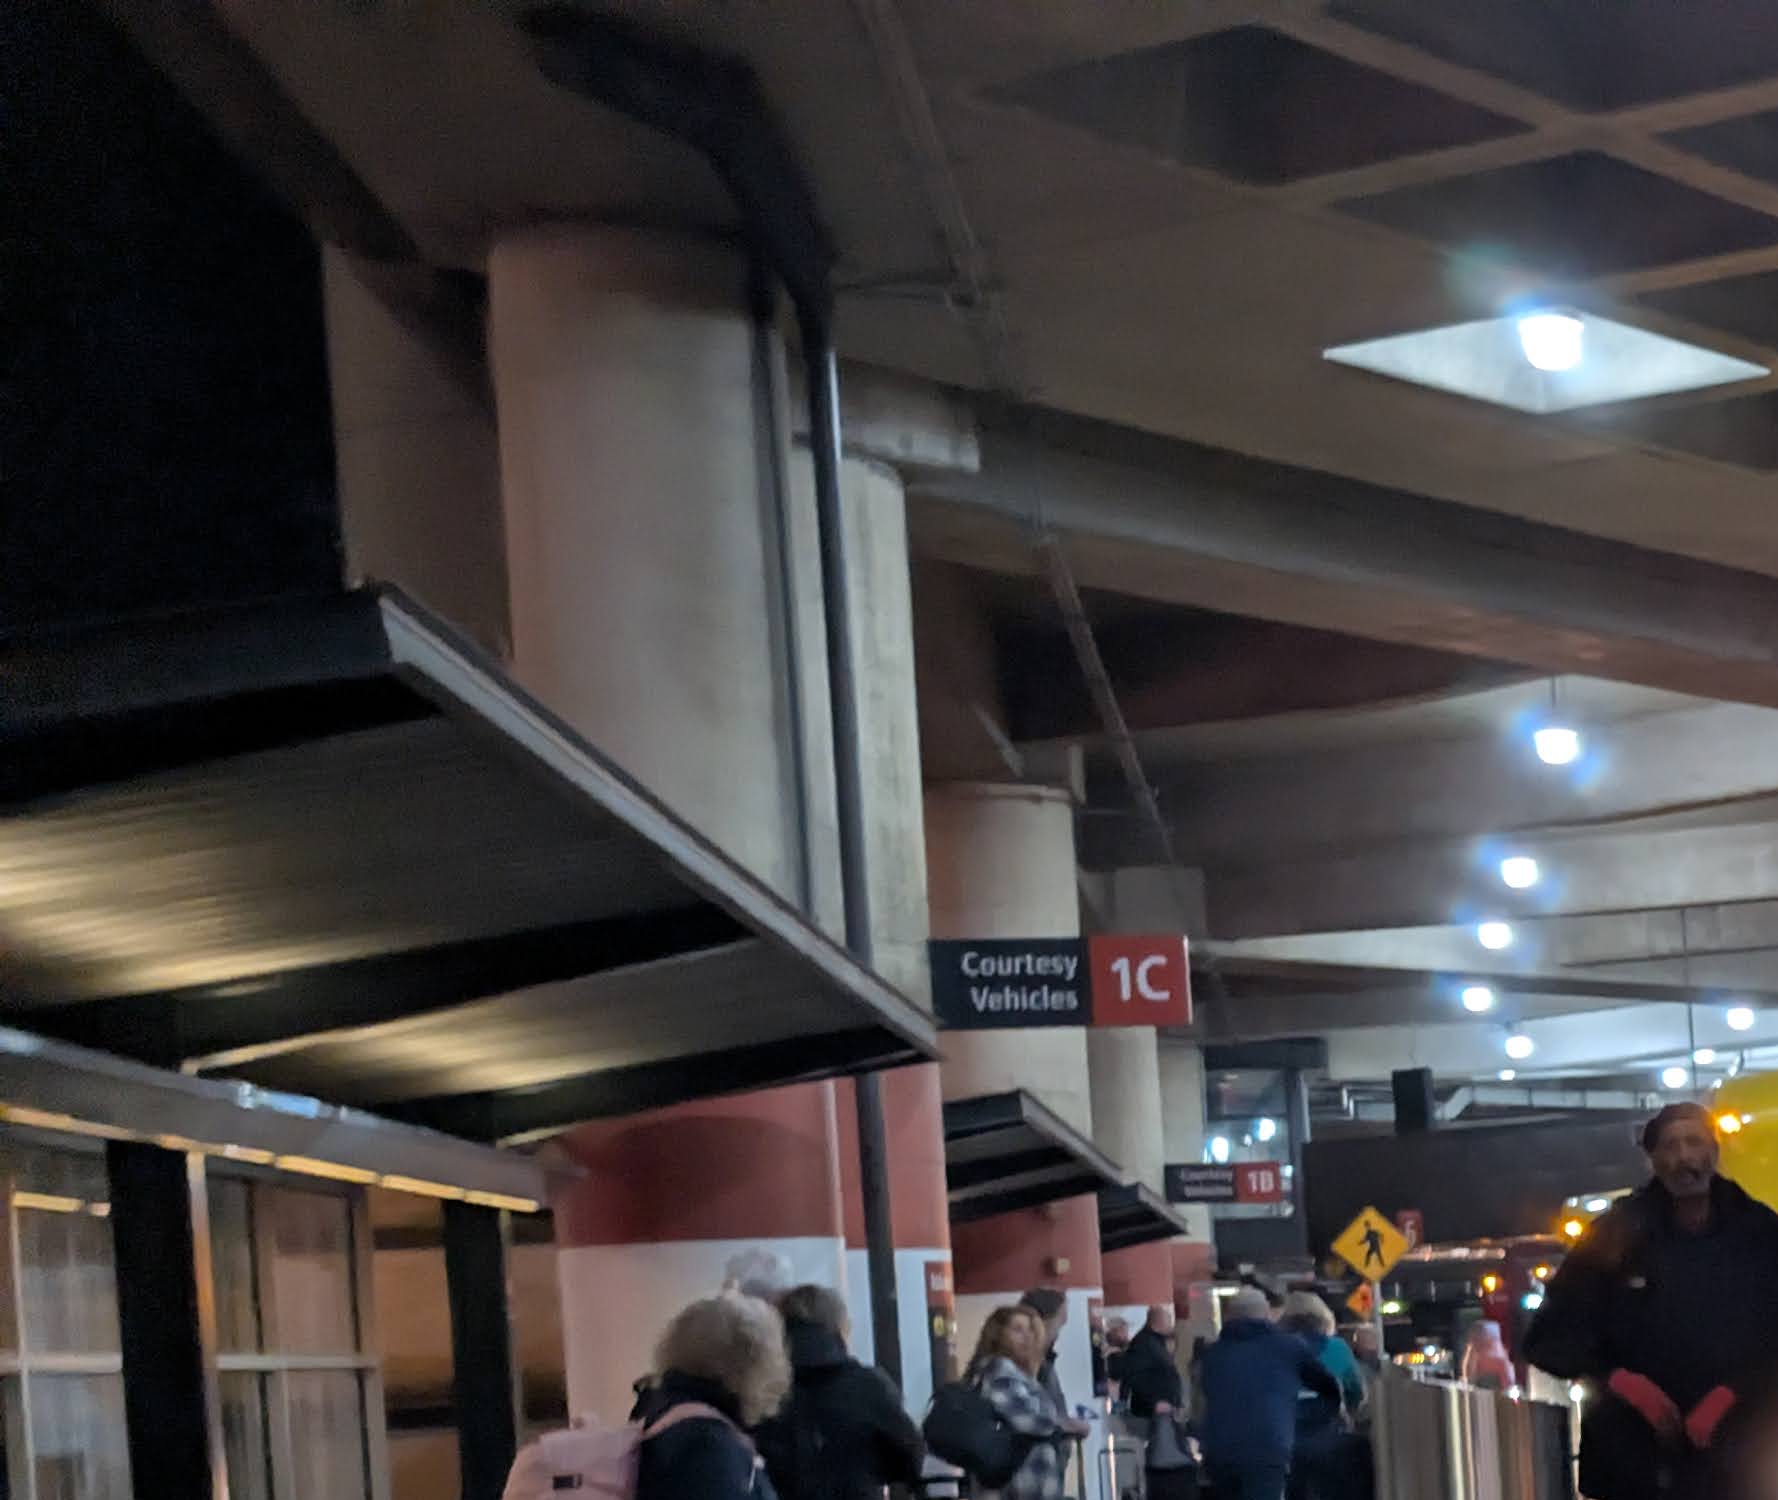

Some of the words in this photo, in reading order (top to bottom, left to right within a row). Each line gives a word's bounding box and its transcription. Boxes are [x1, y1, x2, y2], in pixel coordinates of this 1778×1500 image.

[961, 951, 1078, 980] Courtesy
[1111, 954, 1171, 1003] 1C
[970, 984, 1078, 1012] Vehicles
